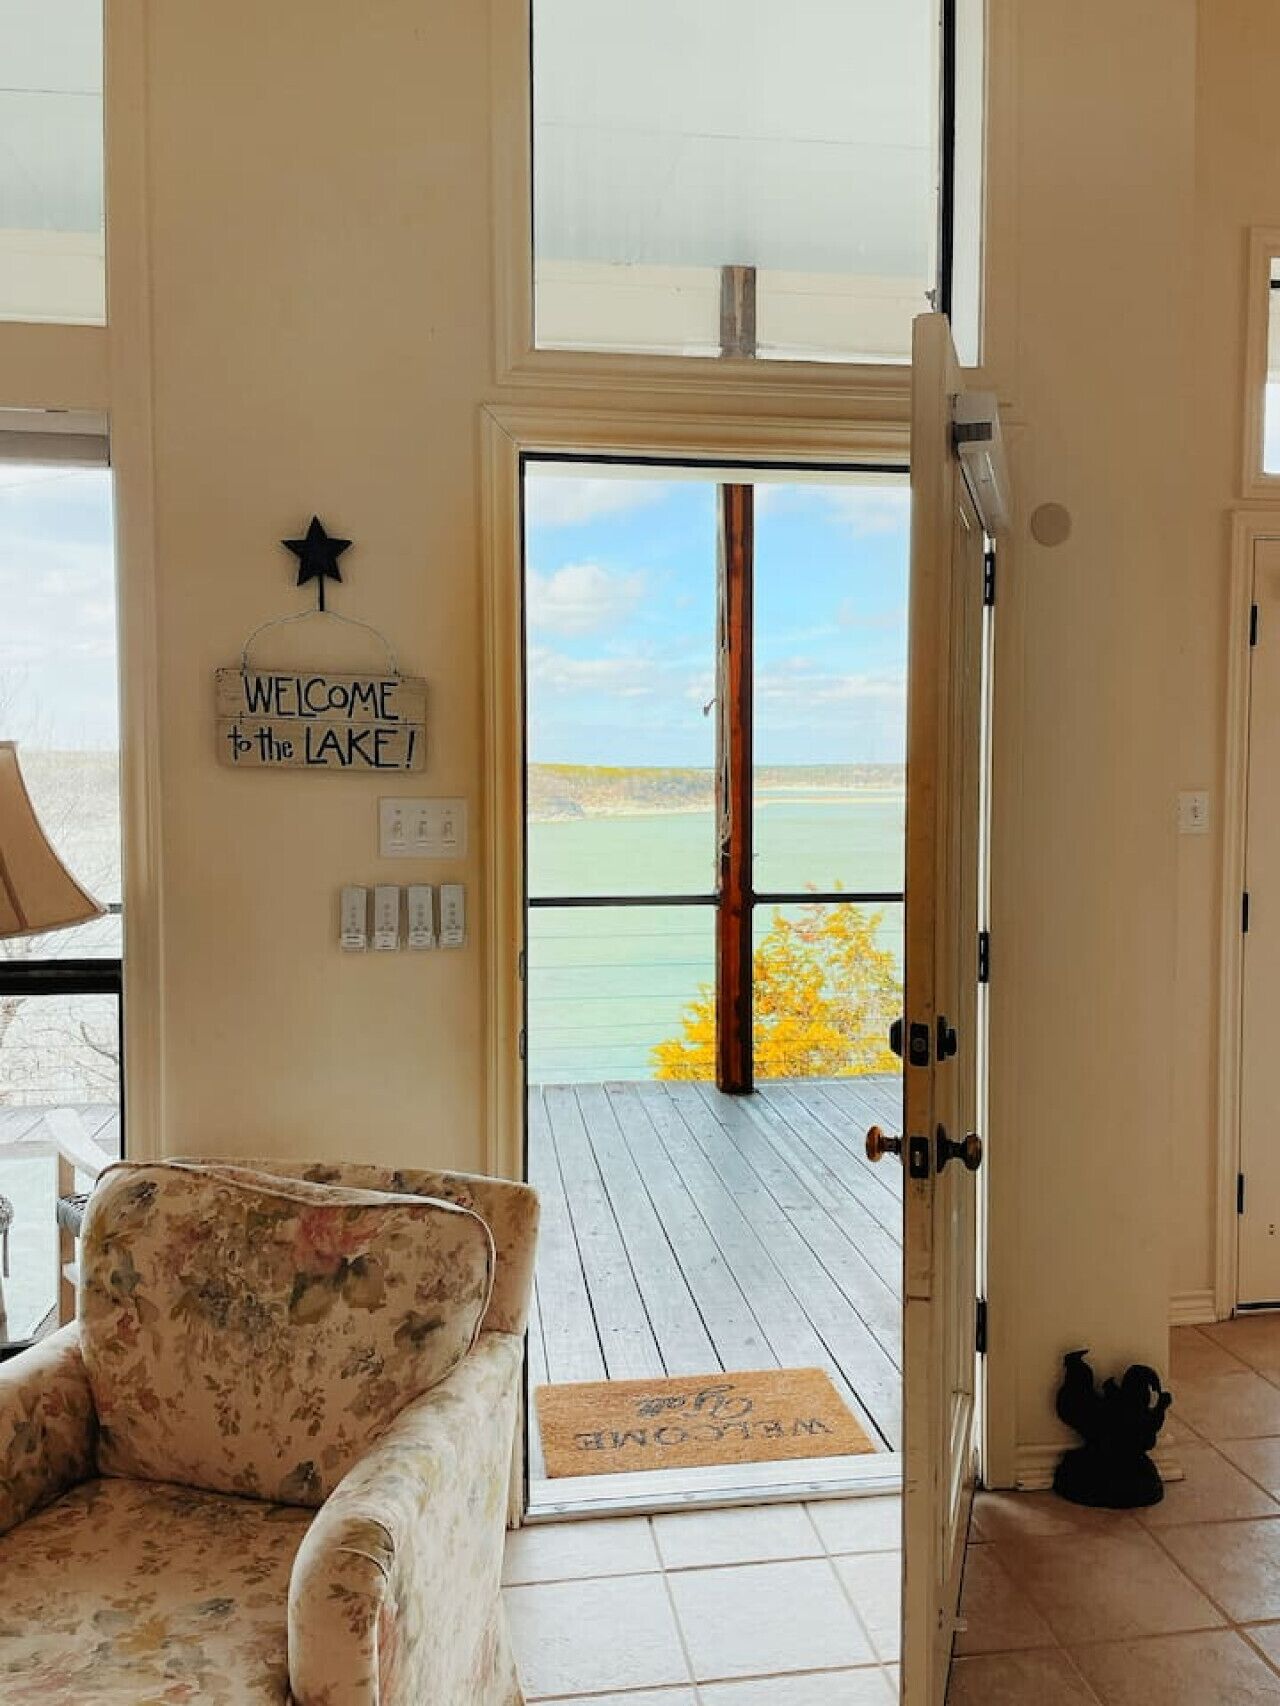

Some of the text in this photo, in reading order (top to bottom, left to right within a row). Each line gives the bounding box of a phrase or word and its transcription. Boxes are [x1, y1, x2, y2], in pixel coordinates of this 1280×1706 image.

[227, 725, 415, 768] to the LAKE!
[575, 1418, 833, 1450] WELCOME
